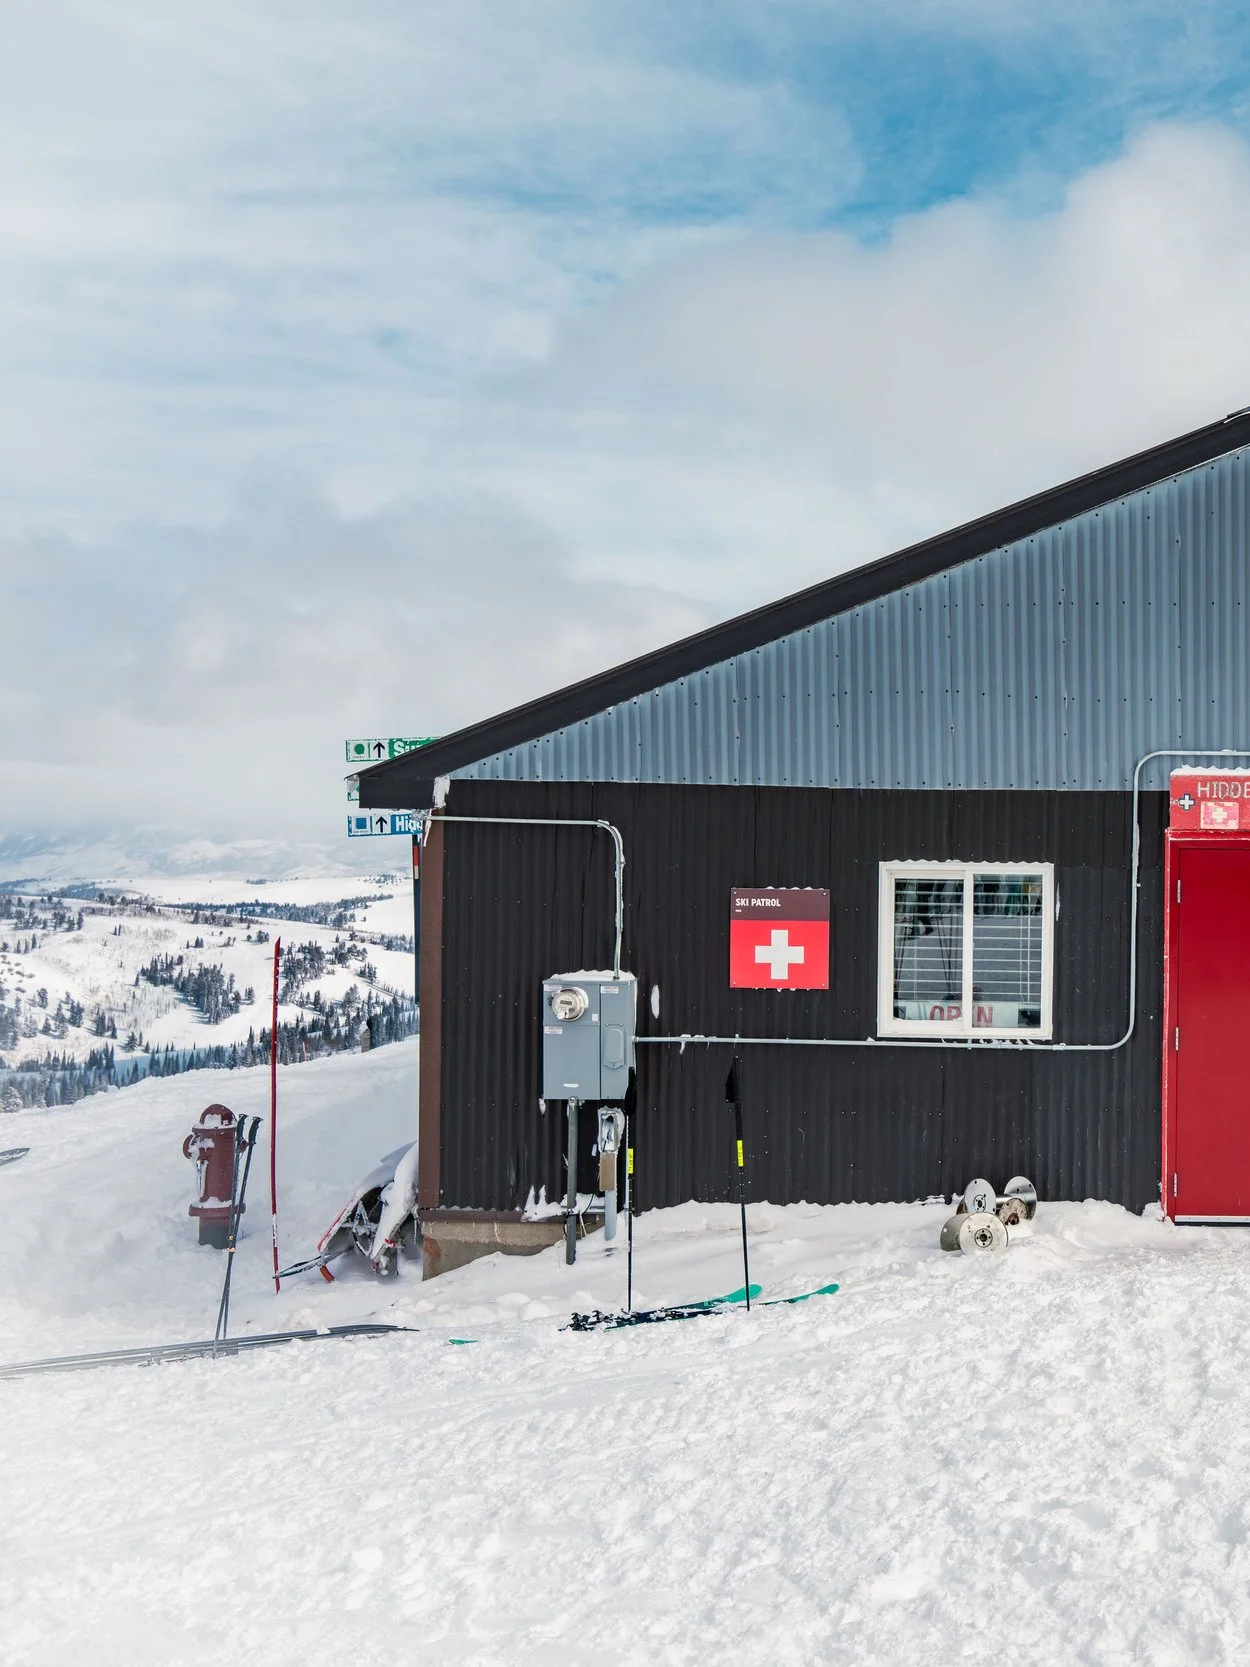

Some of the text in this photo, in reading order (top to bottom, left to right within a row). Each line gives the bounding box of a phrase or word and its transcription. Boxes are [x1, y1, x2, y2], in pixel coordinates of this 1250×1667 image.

[735, 898, 781, 907] SKI PATROL
[929, 1005, 993, 1026] OPN
